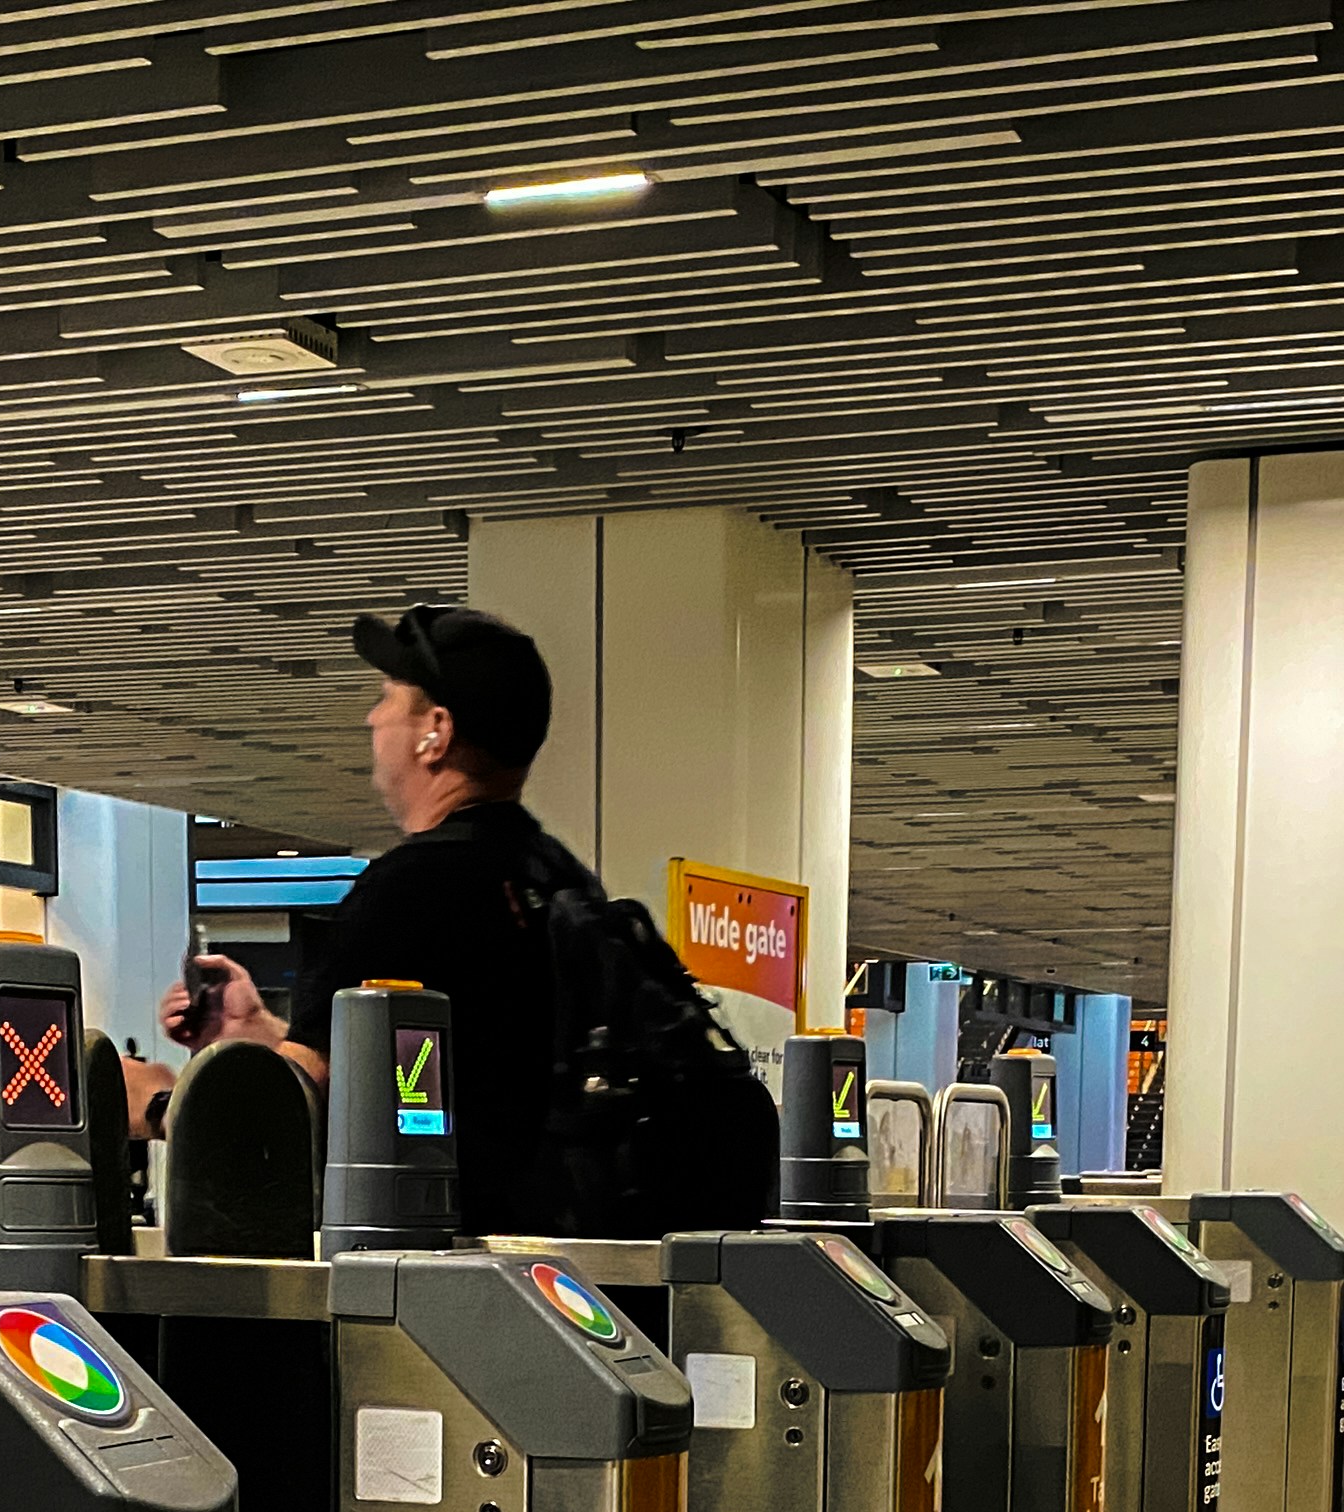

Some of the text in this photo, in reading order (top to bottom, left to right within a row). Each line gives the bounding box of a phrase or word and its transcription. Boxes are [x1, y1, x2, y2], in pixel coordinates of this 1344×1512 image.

[689, 901, 786, 965] Wide gate
[751, 1045, 783, 1065] clear for
[1205, 1434, 1222, 1453] Eas
[1205, 1460, 1222, 1476] acc
[1090, 1476, 1104, 1503] Ta
